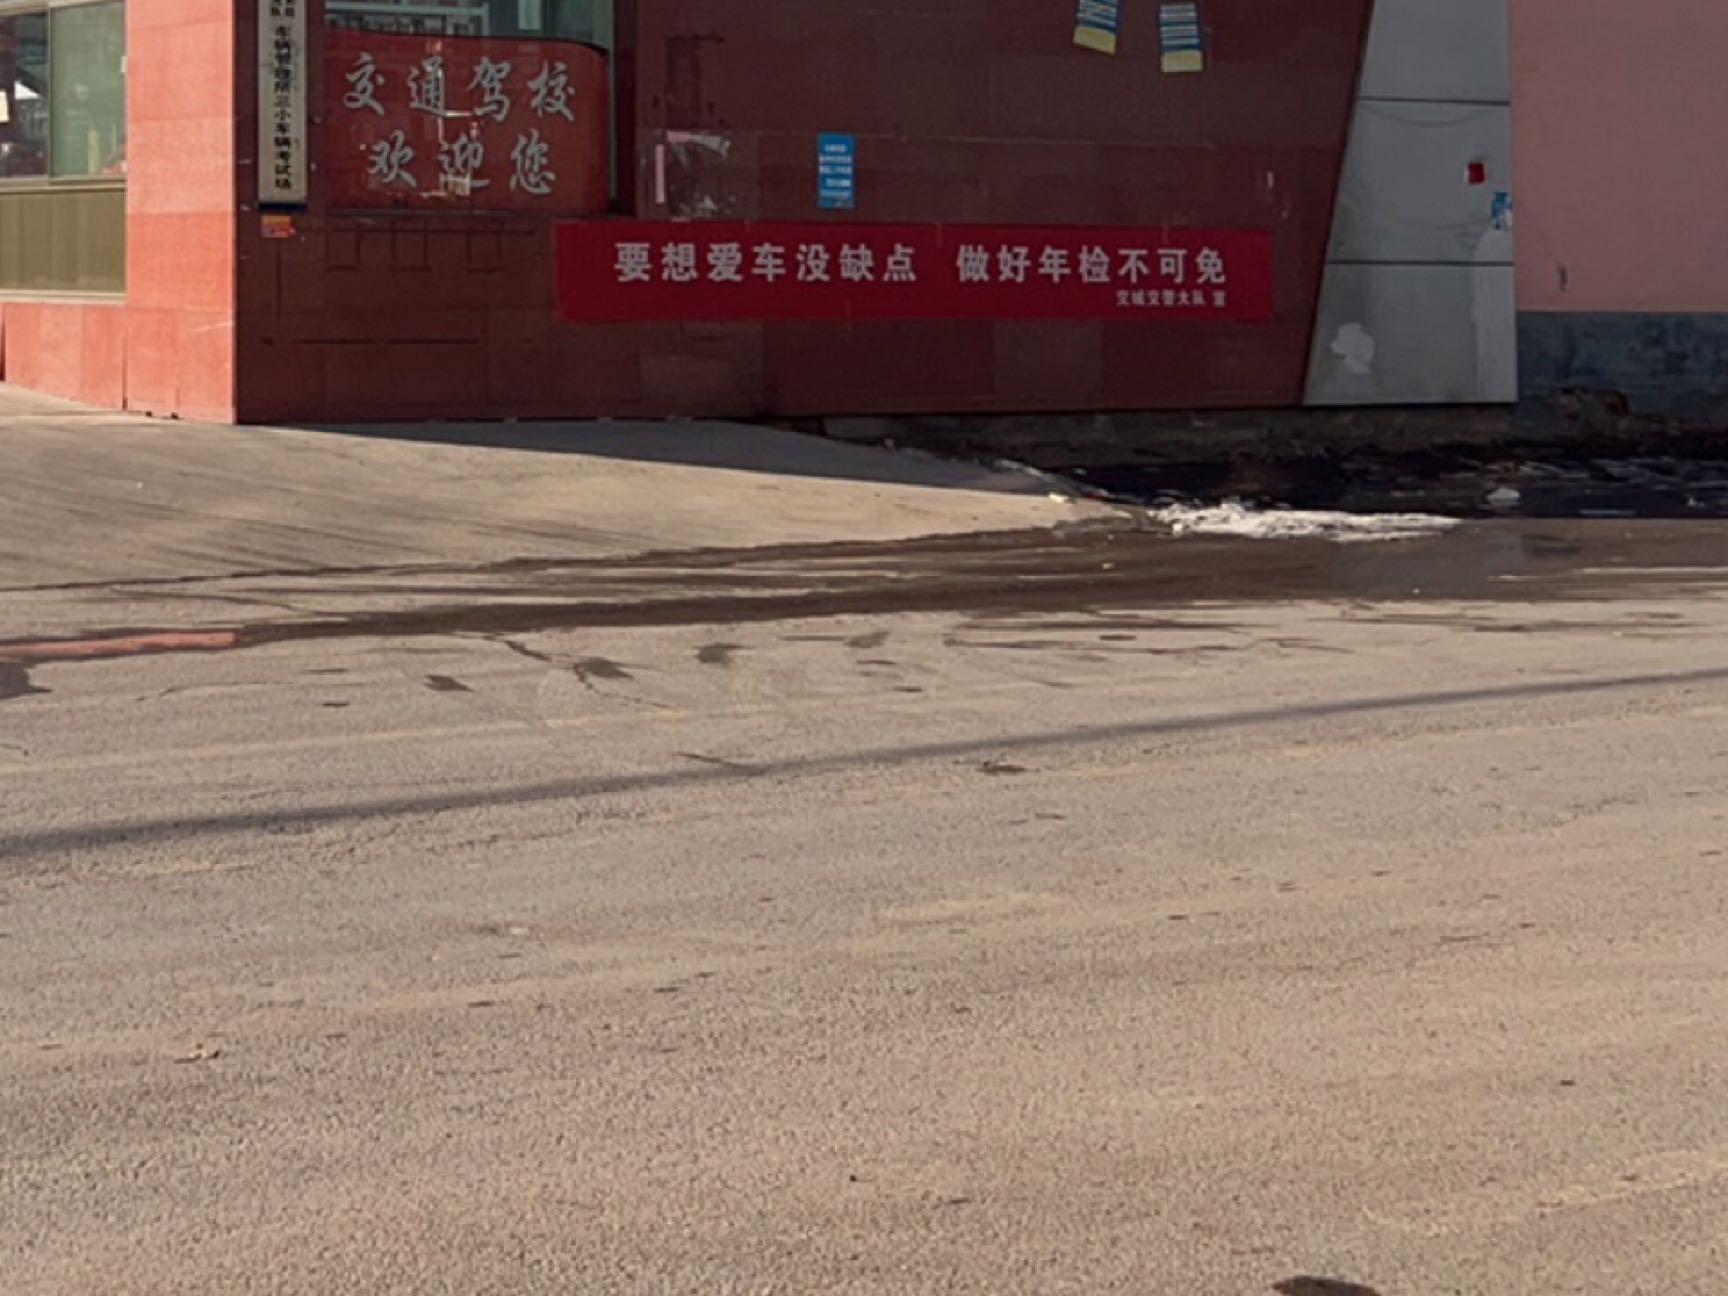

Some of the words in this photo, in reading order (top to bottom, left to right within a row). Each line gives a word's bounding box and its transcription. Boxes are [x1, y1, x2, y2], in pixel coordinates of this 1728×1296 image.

[344, 52, 576, 124] 交通驾校
[366, 128, 557, 196] 欢迎您
[614, 242, 918, 284] 要想爱车没缺点
[956, 244, 1227, 285] 做好年检不可免
